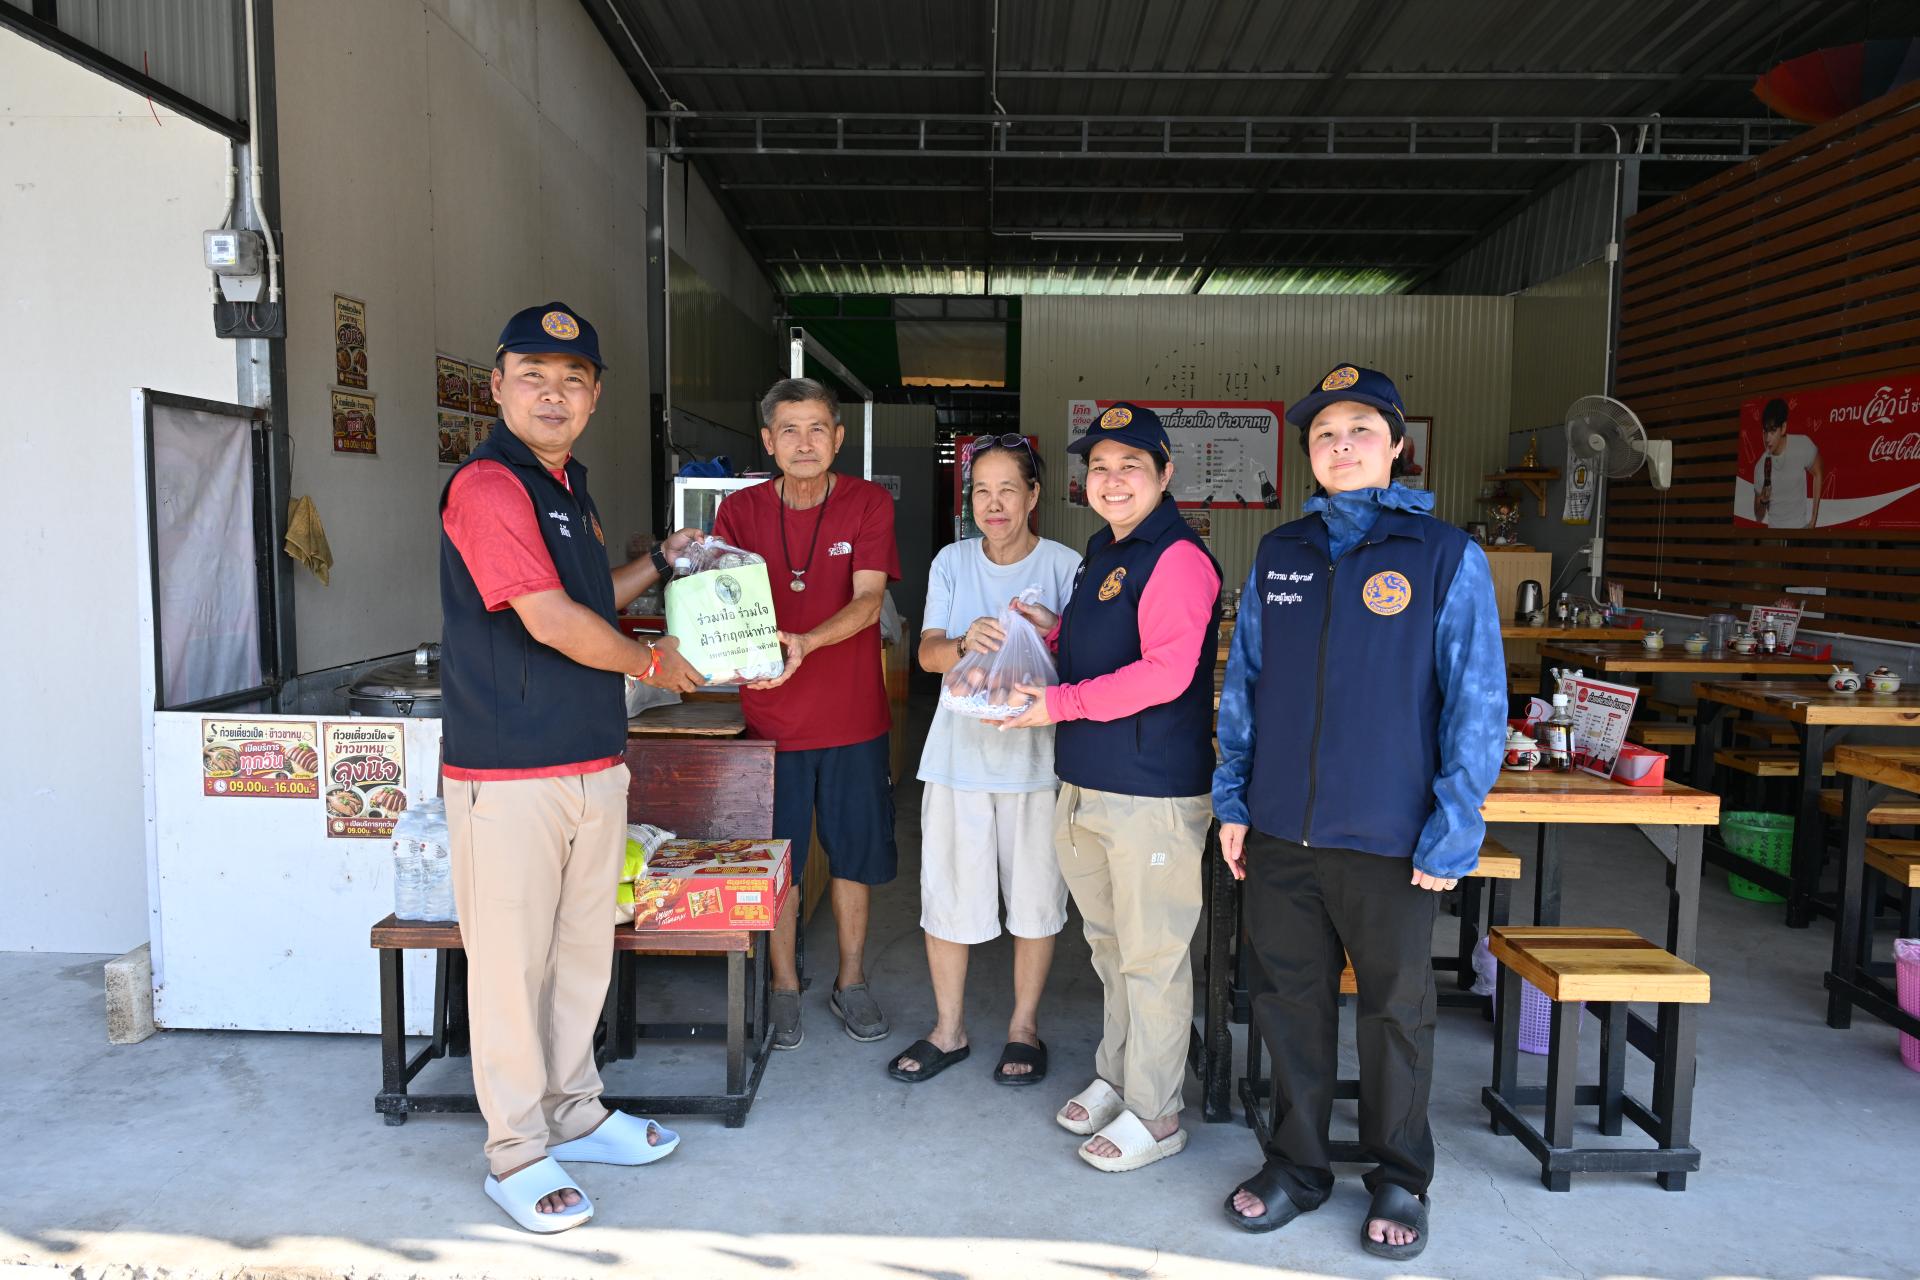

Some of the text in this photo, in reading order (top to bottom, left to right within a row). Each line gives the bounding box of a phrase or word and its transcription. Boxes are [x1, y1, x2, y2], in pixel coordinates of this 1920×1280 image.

[1829, 405, 1862, 423] ความ
[1217, 412, 1271, 433] ข้าวขาหมู
[738, 602, 769, 618] ร่วมใจ
[269, 728, 302, 741] ข้าวขาหมู
[333, 727, 387, 740] ก๋วยเตี๋ยวเป็ด
[245, 743, 280, 752] เปิดบริการ
[335, 742, 384, 757] ข้าวขาหมู
[240, 752, 284, 775] ทุกวัน
[334, 755, 399, 791] ลุงนิจ
[229, 781, 269, 792] 09.00น.
